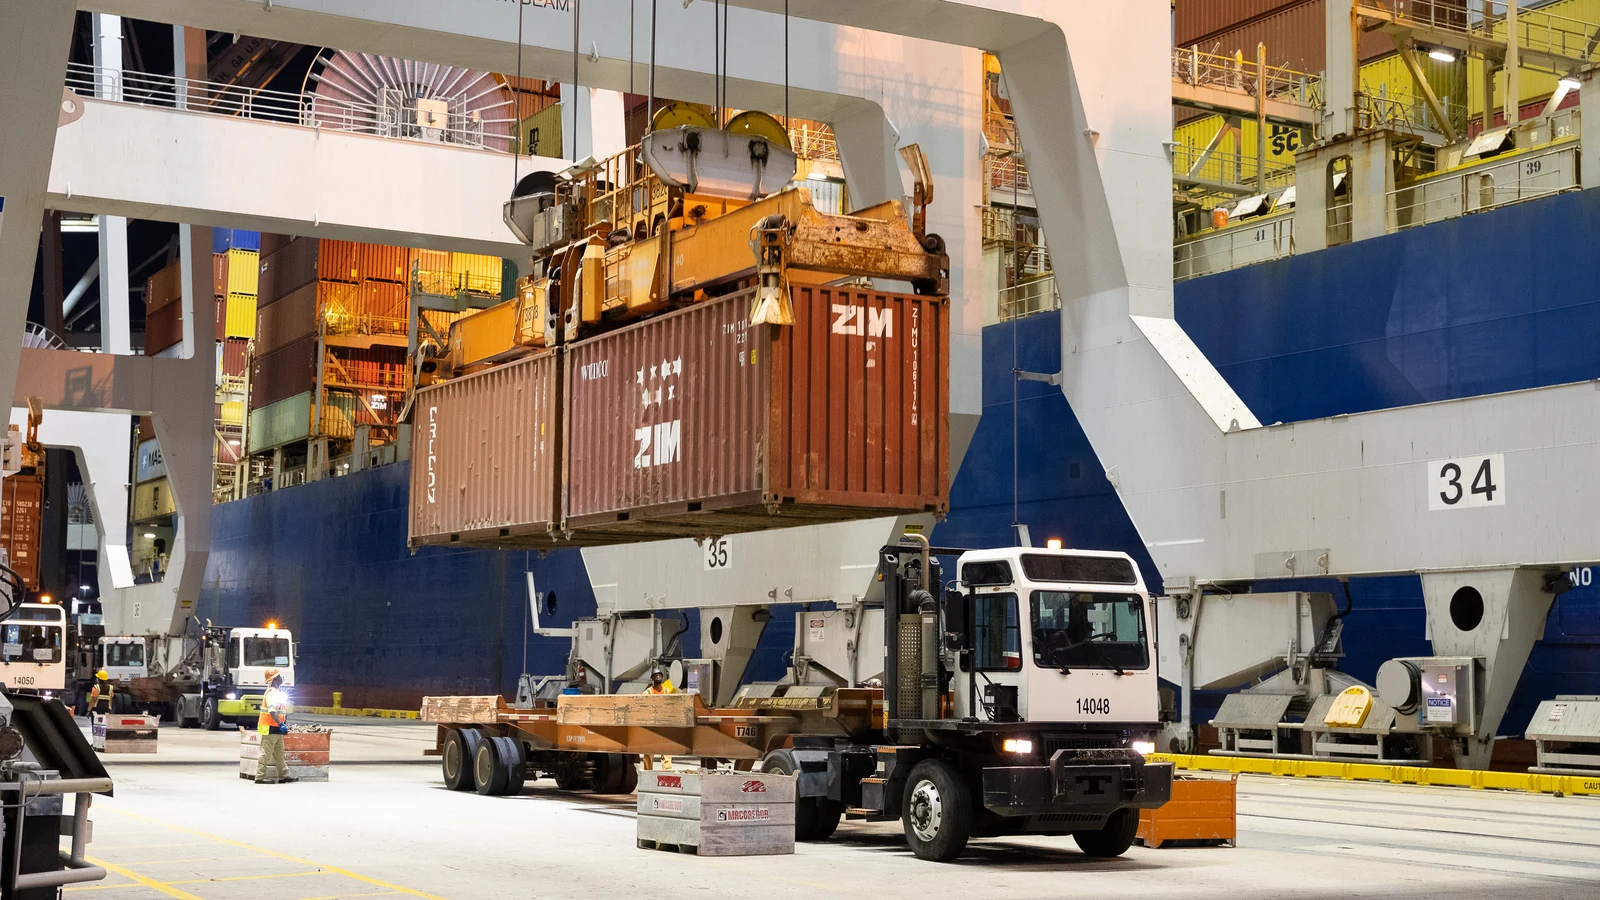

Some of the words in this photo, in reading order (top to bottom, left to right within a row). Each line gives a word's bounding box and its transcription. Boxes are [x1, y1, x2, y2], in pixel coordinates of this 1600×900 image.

[522, 0, 569, 12] AM
[1526, 160, 1541, 175] 39
[1254, 229, 1265, 241] 41
[832, 304, 893, 338] ZIM
[370, 402, 387, 410] ZIM
[634, 419, 681, 469] ZIM
[1440, 458, 1497, 506] 34
[708, 540, 728, 568] 35
[13, 676, 35, 685] 14050
[1076, 697, 1110, 715] 14048
[1428, 699, 1450, 707] NOTICE
[736, 726, 756, 737] T746
